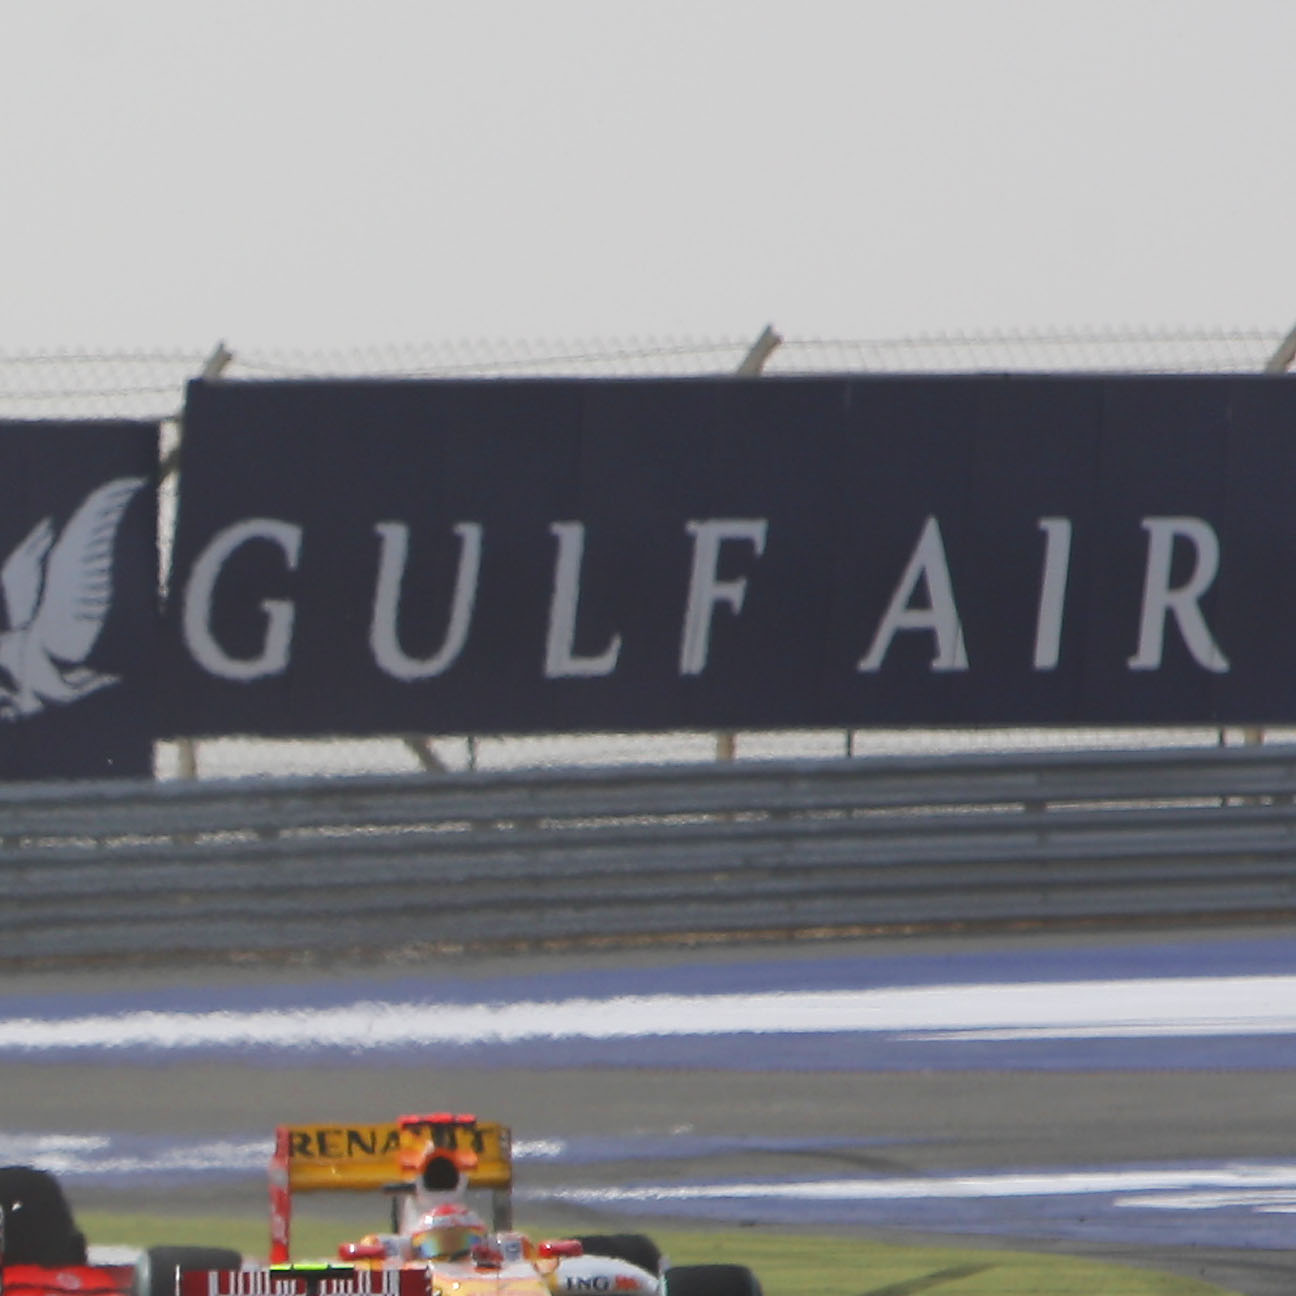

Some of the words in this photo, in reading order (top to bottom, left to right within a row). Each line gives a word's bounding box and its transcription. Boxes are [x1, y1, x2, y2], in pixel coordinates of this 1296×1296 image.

[181, 517, 768, 681] GULF
[858, 515, 1231, 674] AIR
[566, 1275, 610, 1291] ING
